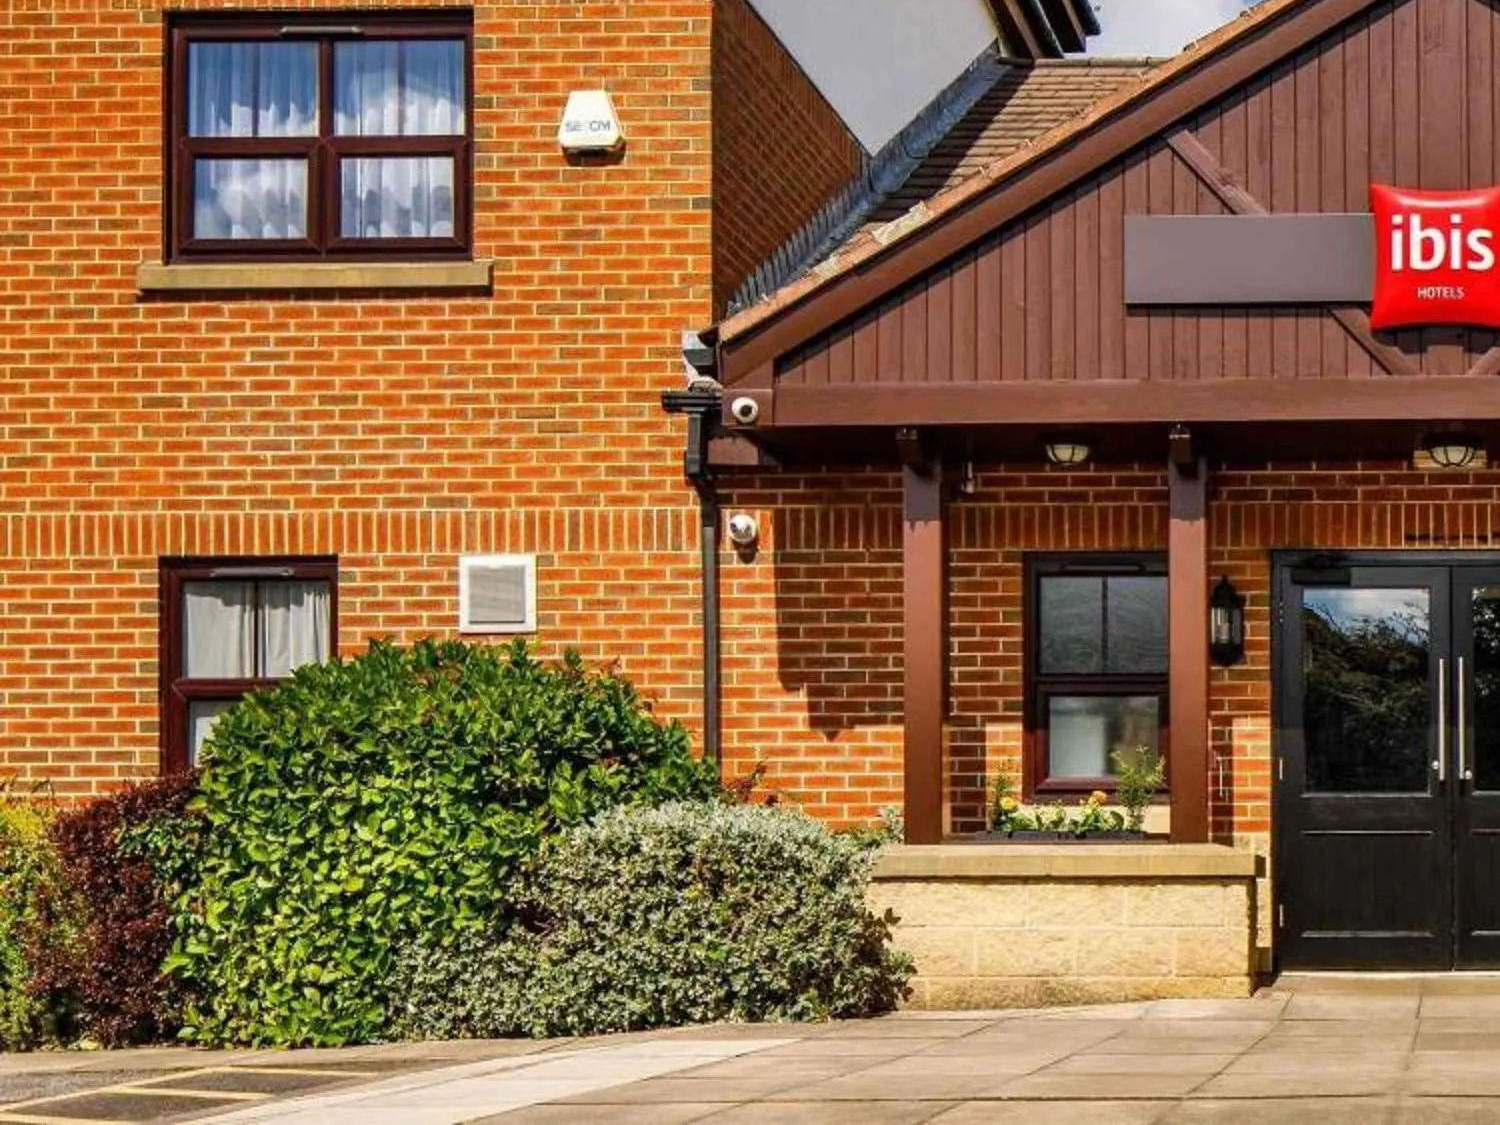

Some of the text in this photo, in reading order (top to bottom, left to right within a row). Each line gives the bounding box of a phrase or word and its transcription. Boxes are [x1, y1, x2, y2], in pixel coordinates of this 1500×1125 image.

[565, 120, 611, 132] SEOM
[1391, 213, 1495, 271] ibis
[1417, 286, 1465, 299] HOTELS
